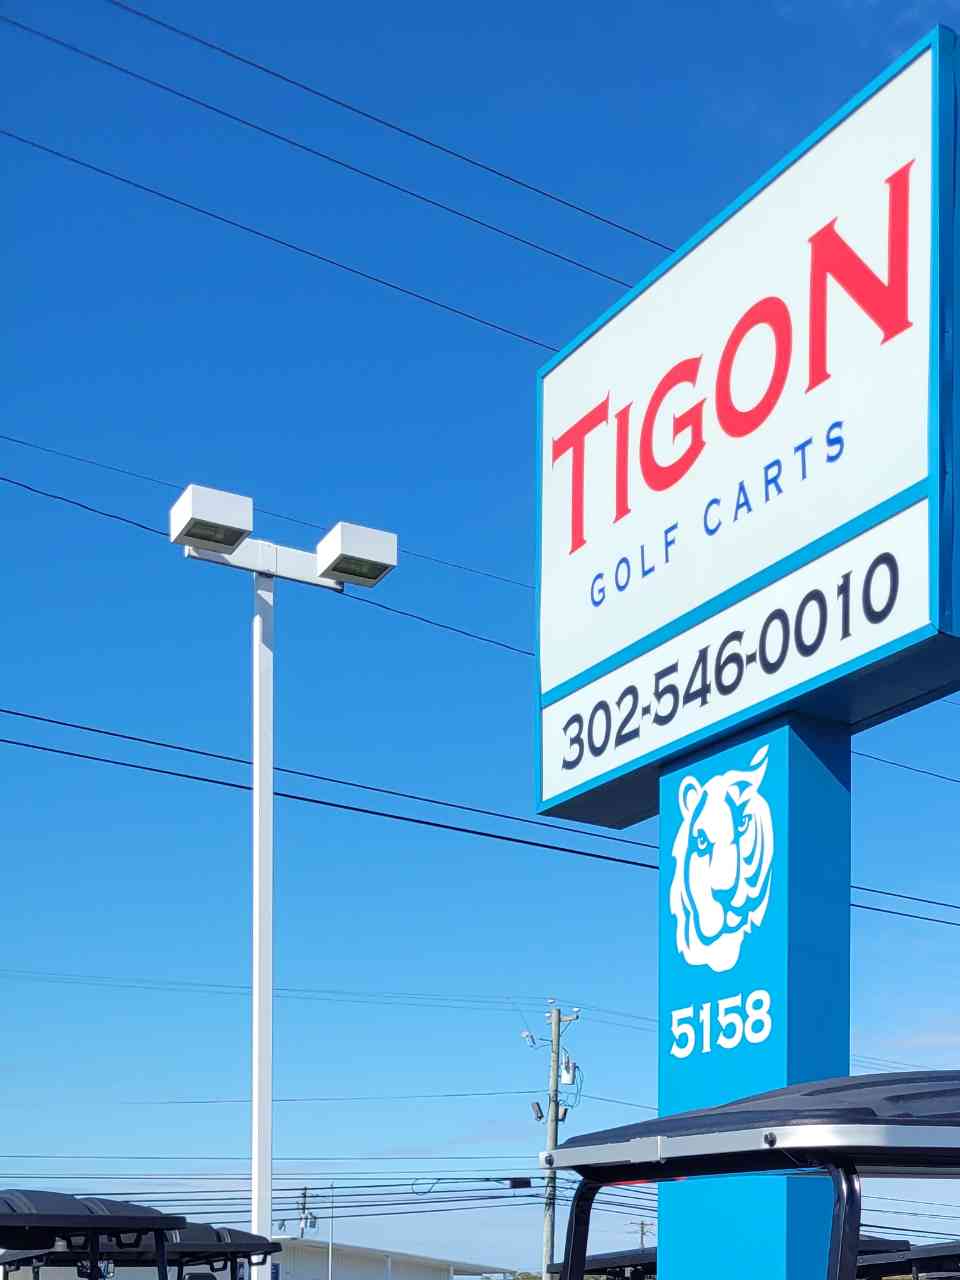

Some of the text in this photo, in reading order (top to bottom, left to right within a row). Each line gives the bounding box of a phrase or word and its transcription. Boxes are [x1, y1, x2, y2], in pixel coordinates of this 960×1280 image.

[551, 159, 916, 555] TIGON
[590, 420, 845, 607] GOLF CARTS
[561, 551, 900, 771] 302-546-0010
[669, 988, 773, 1059] 5158
